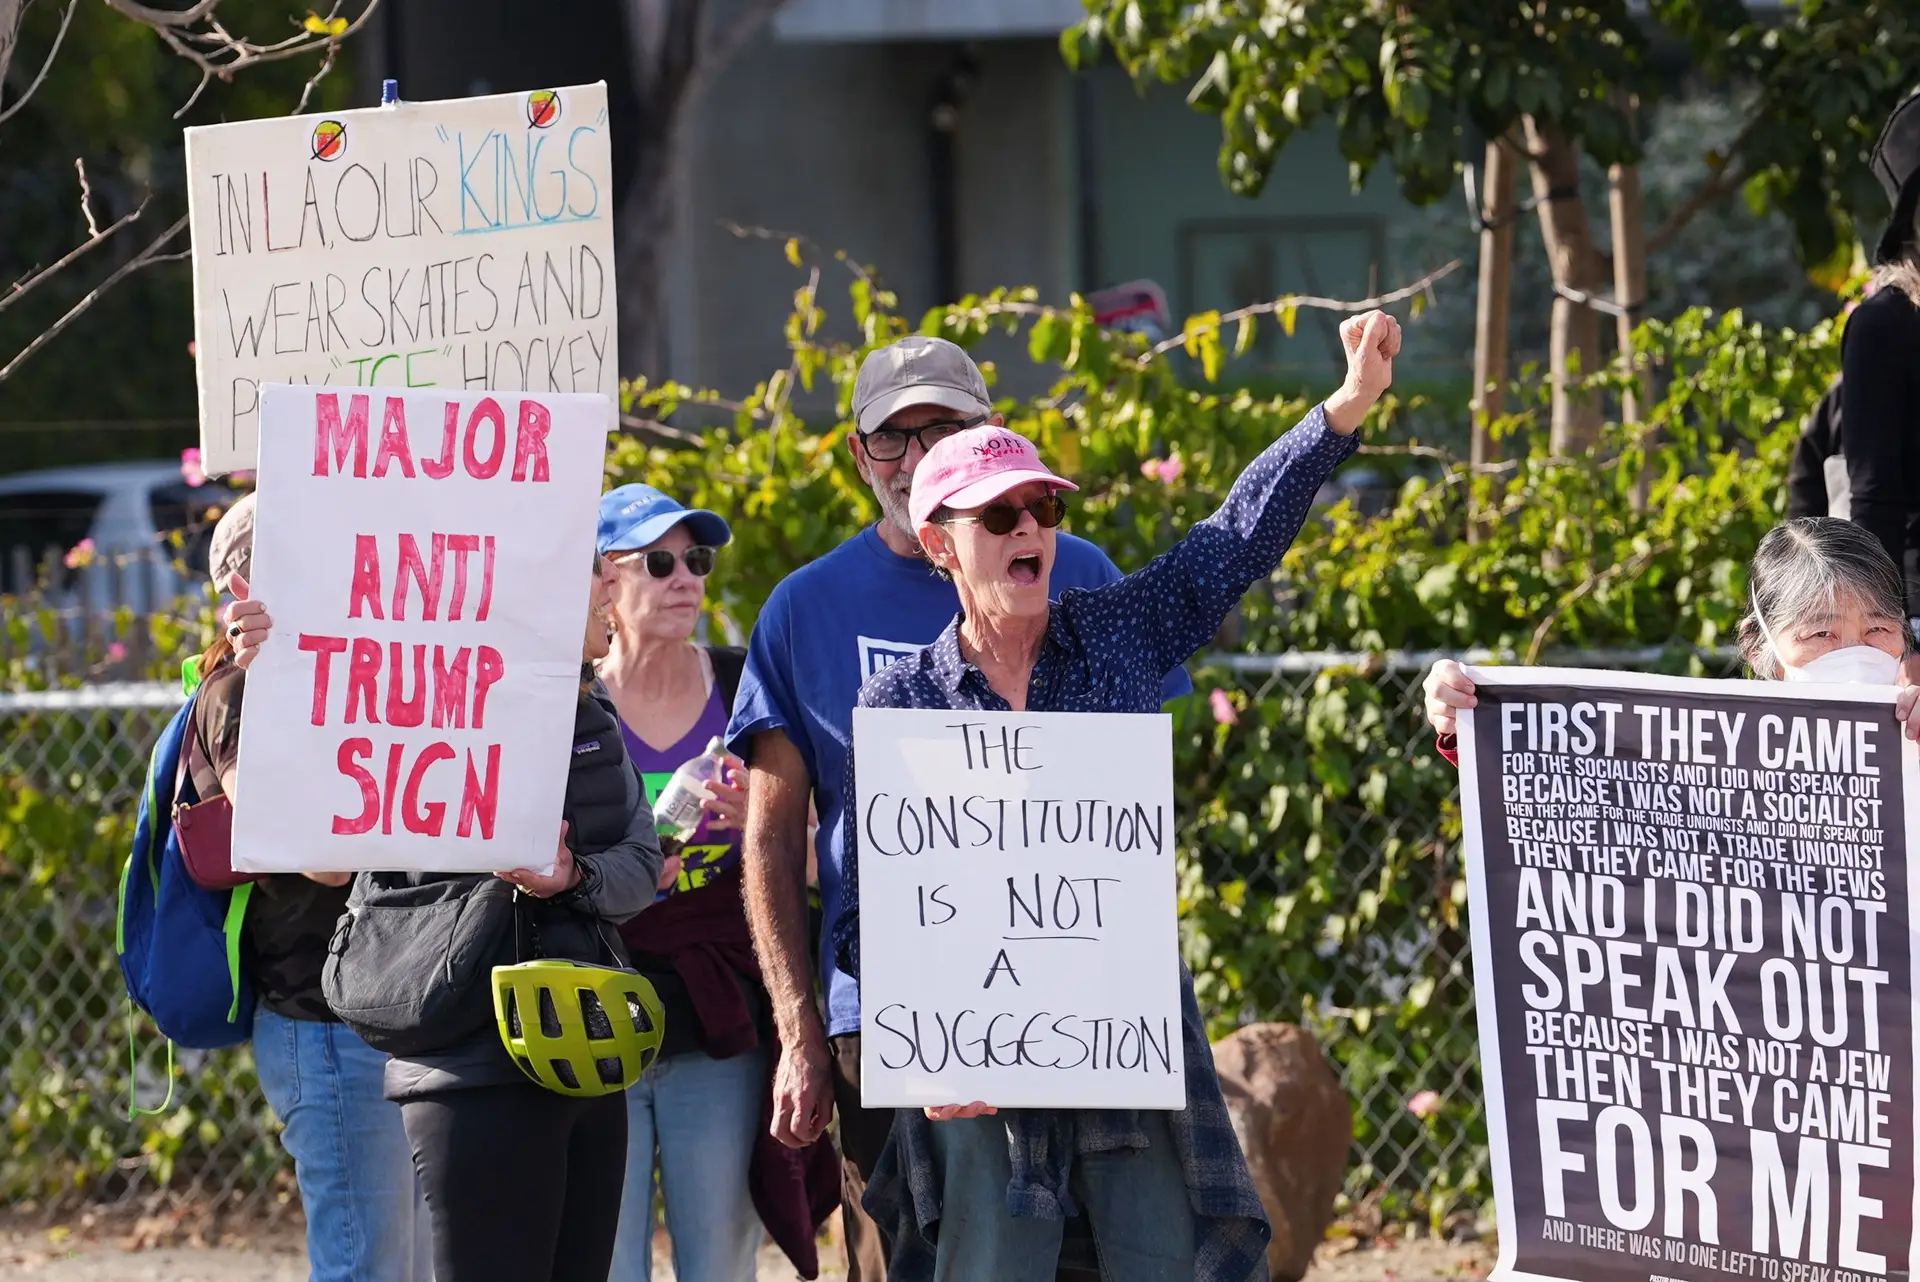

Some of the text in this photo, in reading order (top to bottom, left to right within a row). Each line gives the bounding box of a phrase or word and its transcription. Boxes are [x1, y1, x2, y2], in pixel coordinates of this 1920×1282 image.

[212, 171, 251, 255] IN
[335, 157, 443, 242] OUR
[223, 245, 604, 358] WEAR SKATES AND
[463, 326, 608, 393] HOCKEY
[311, 393, 550, 482] MAJOR
[347, 532, 496, 622] ANTI
[298, 633, 504, 730] TRUMP
[946, 723, 1043, 774] THE
[1502, 702, 1879, 775] FIRST THEY CAME
[332, 737, 501, 840] SIGN
[1503, 753, 1880, 798] FOR THE SOCIALISTS AND I DID NOT SPEAK OUT
[1503, 774, 1882, 828] BECAUSE I WAS NOT A SOCIALIST
[865, 793, 1163, 856] CONSTITUTION
[1504, 802, 1883, 843] THEN THEY CAME FOR THE TRADE UNIONISTS AND I DID NOT SPEAK OUT
[1507, 817, 1883, 869] BECAUSE I WAS NOT A TRADE UNIONIST
[917, 873, 1121, 930] IS NOT
[1509, 839, 1885, 900] THEN THEY CAME FOR THE JEWS
[1516, 867, 1887, 967] AND I DID NOT
[983, 948, 1021, 989] A
[1520, 930, 1889, 1051] SPEAK OUT
[874, 1003, 1178, 1074] SUGGESTION.
[1525, 1011, 1890, 1091] BECAUSE I WAS NOT A JEW
[1526, 1046, 1891, 1147] THEN THEY CAME
[1536, 1099, 1889, 1275] FOR ME
[1543, 1219, 1573, 1242] AND
[1578, 1225, 1625, 1252] THERE
[1629, 1233, 1661, 1258] WAS
[1666, 1240, 1685, 1262] NO
[1689, 1245, 1717, 1269] ONE
[1722, 1250, 1756, 1276] LEFT
[1761, 1257, 1778, 1279] TO
[1782, 1262, 1830, 1282] SPEAK
